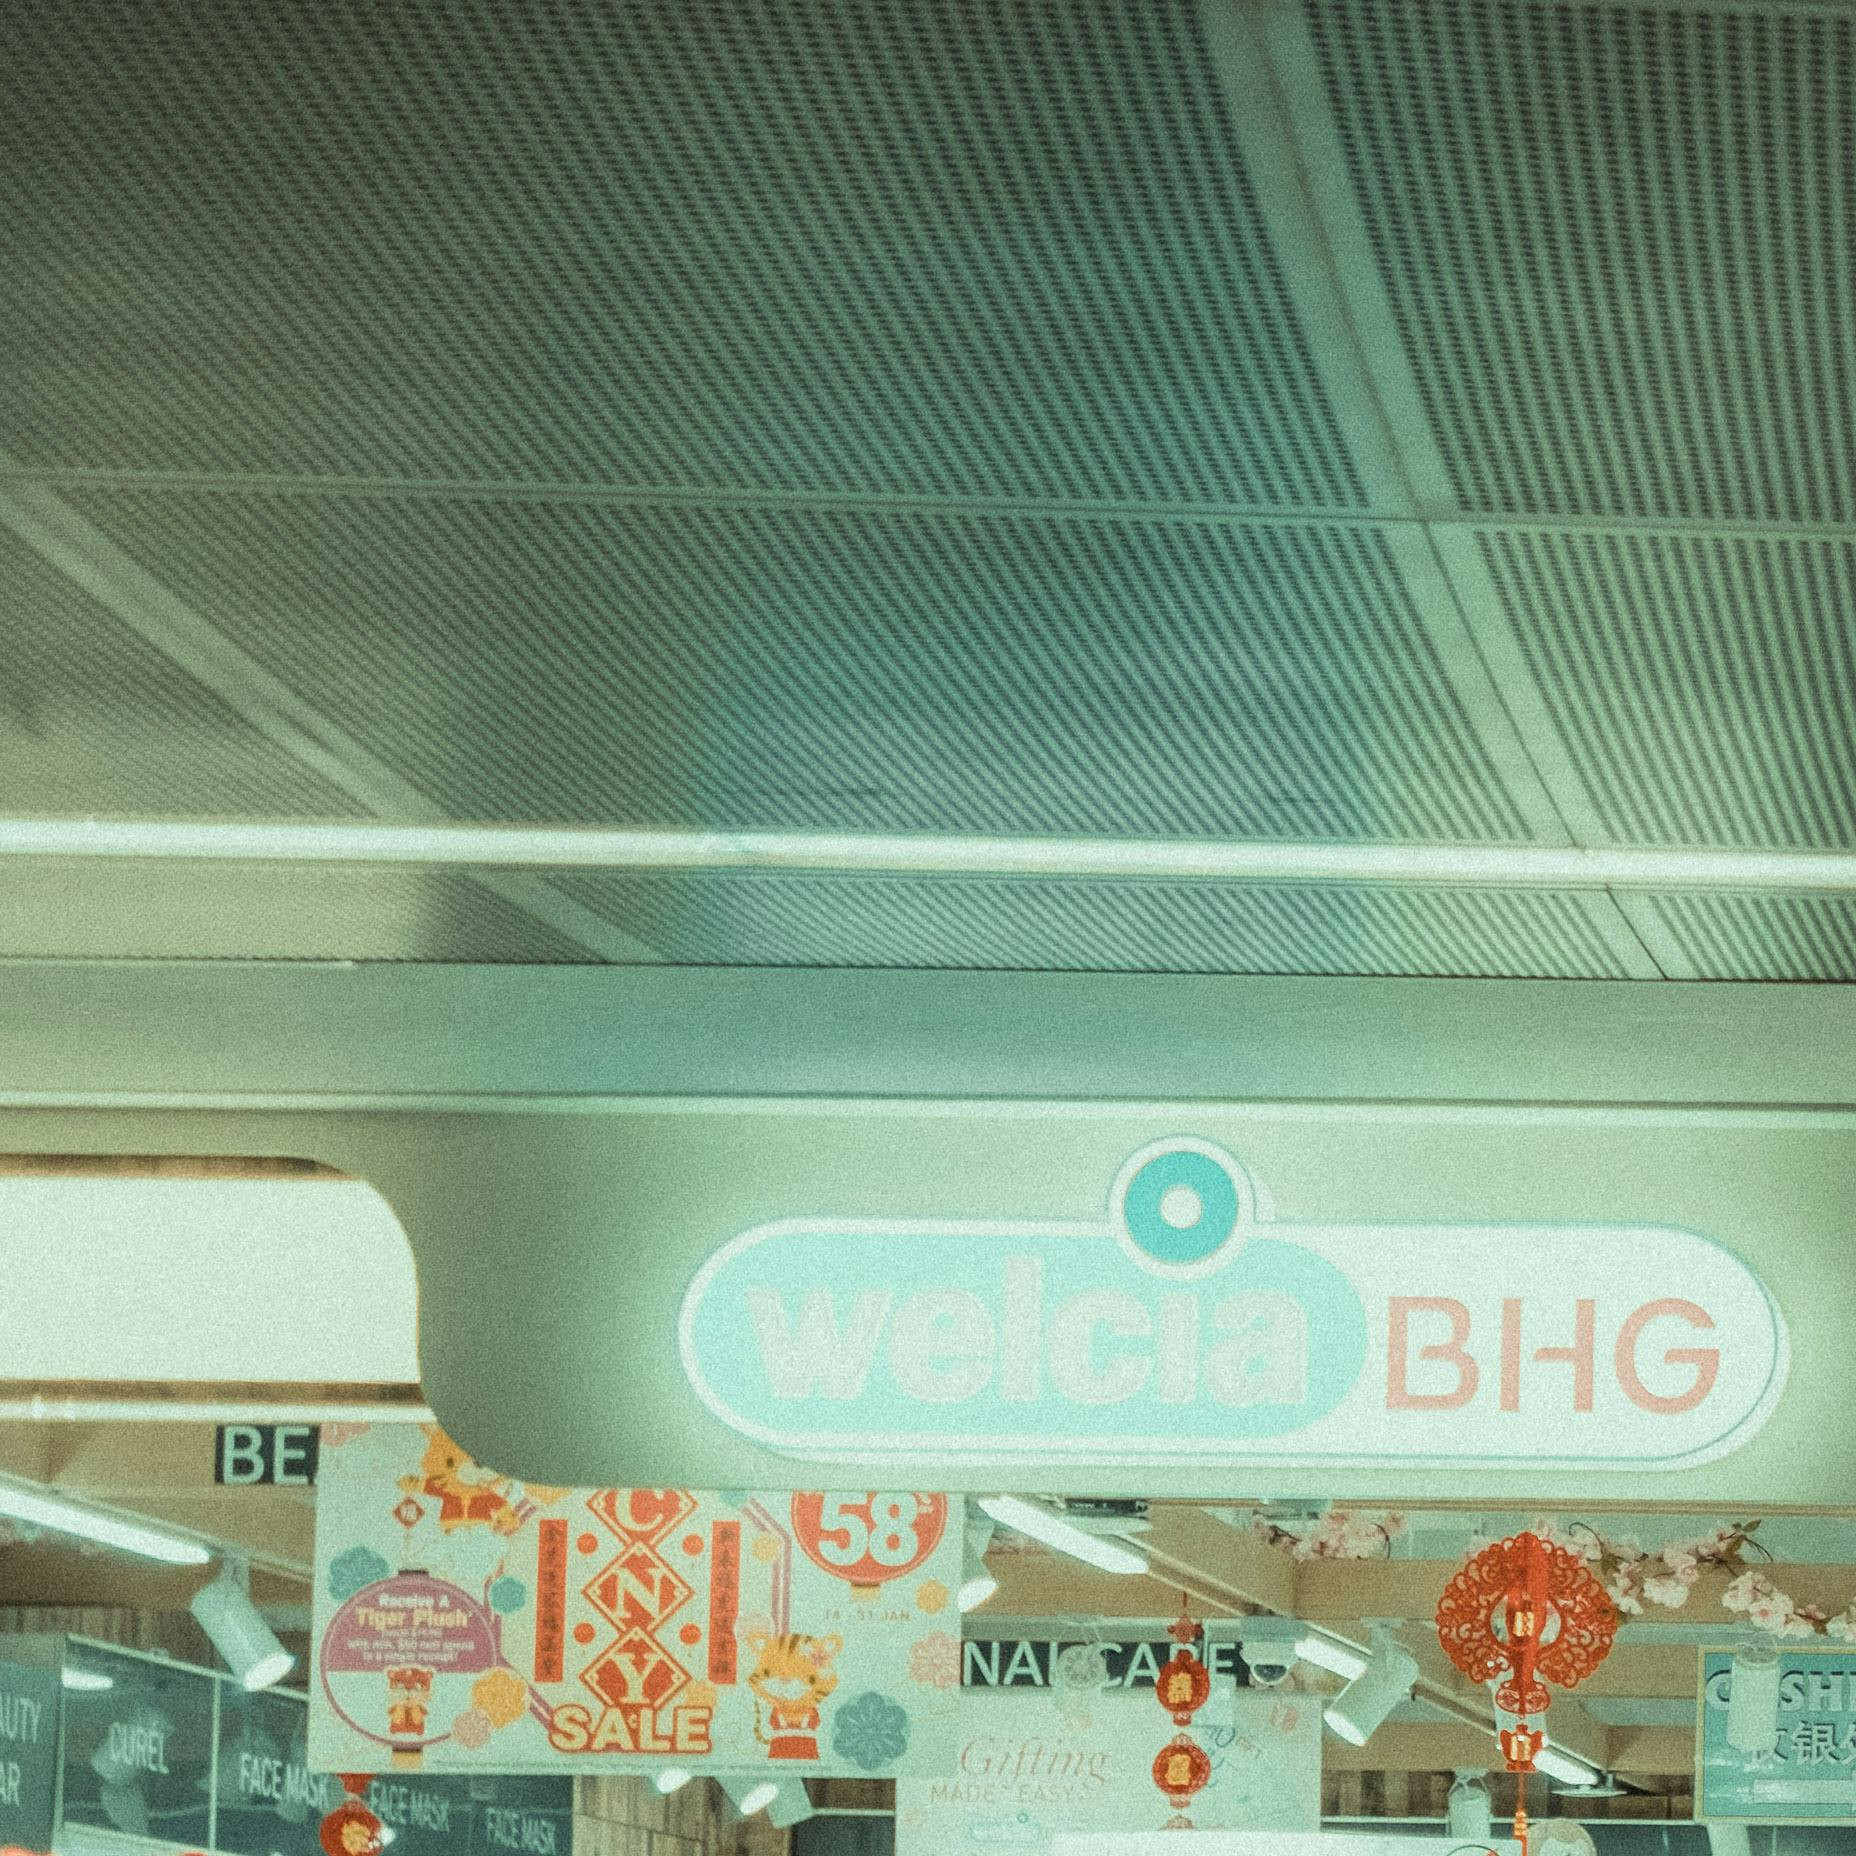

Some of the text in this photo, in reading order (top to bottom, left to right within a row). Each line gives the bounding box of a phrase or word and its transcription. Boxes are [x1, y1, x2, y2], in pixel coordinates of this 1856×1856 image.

[746, 1256, 1721, 1413] welcia BHG
[549, 1706, 713, 1754] SALE
[960, 1736, 1114, 1787] Gifting
